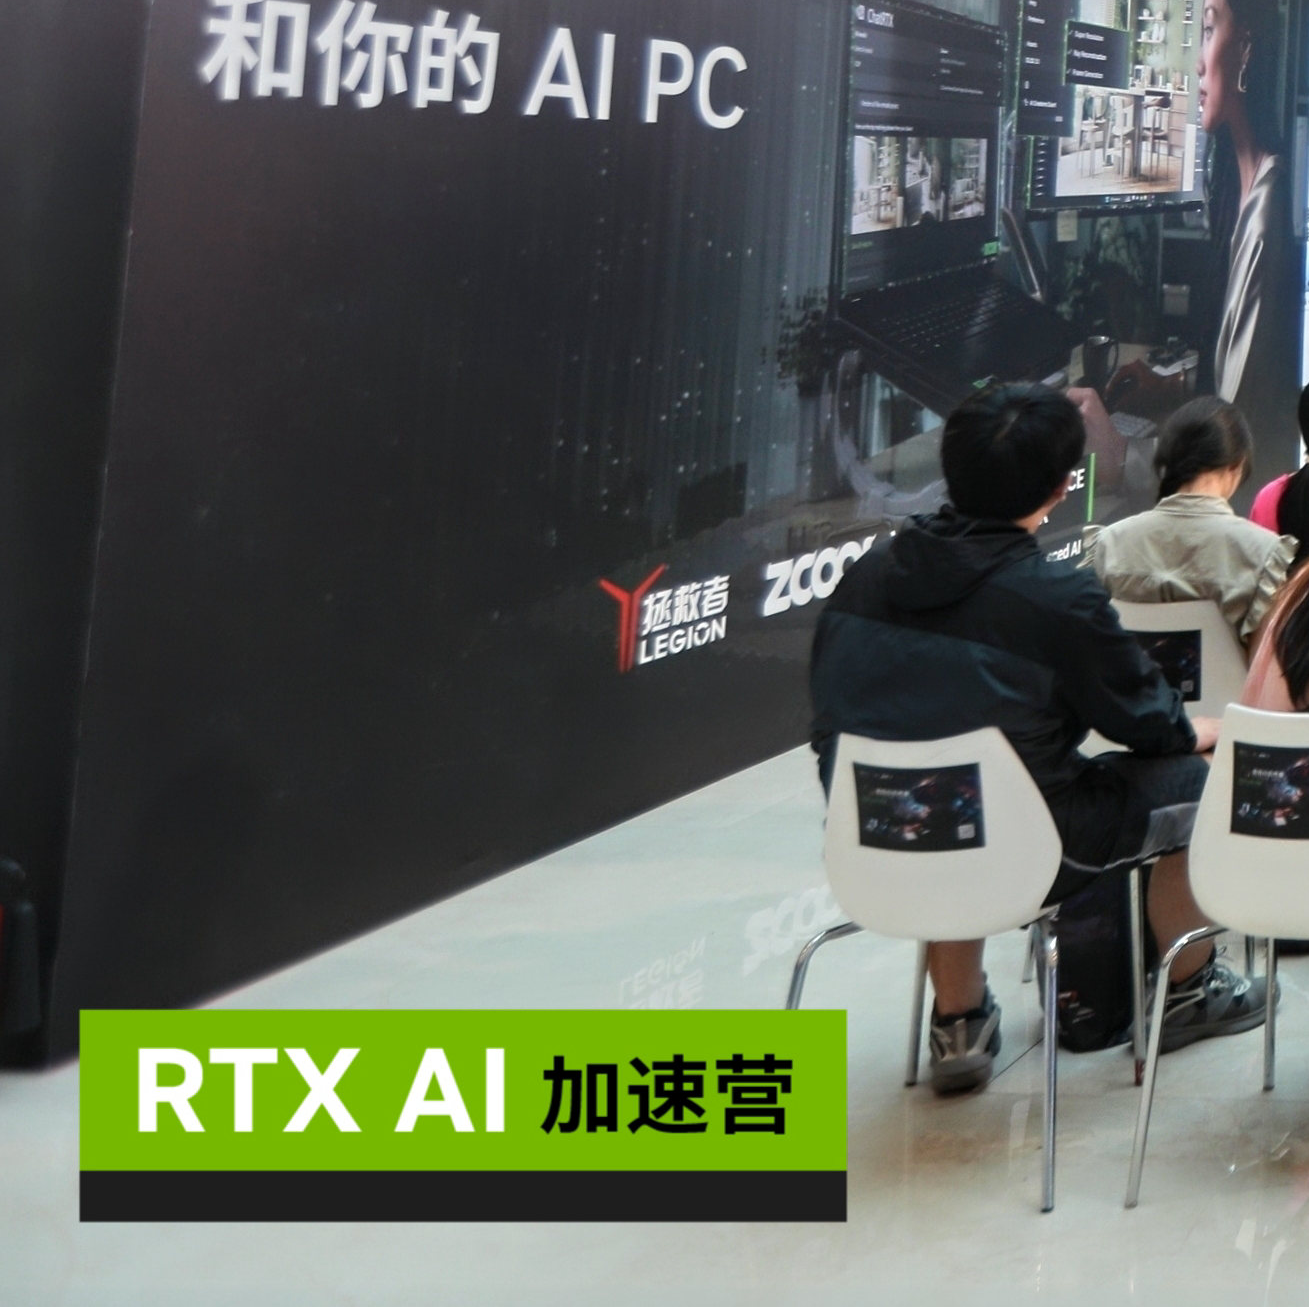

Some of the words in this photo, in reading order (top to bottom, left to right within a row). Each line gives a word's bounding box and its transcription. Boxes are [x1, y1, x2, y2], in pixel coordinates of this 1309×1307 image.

[522, 26, 617, 121] AI
[644, 37, 749, 130] PC
[1070, 539, 1082, 557] AI
[640, 574, 730, 637] 拯救者
[638, 616, 727, 666] LEGION
